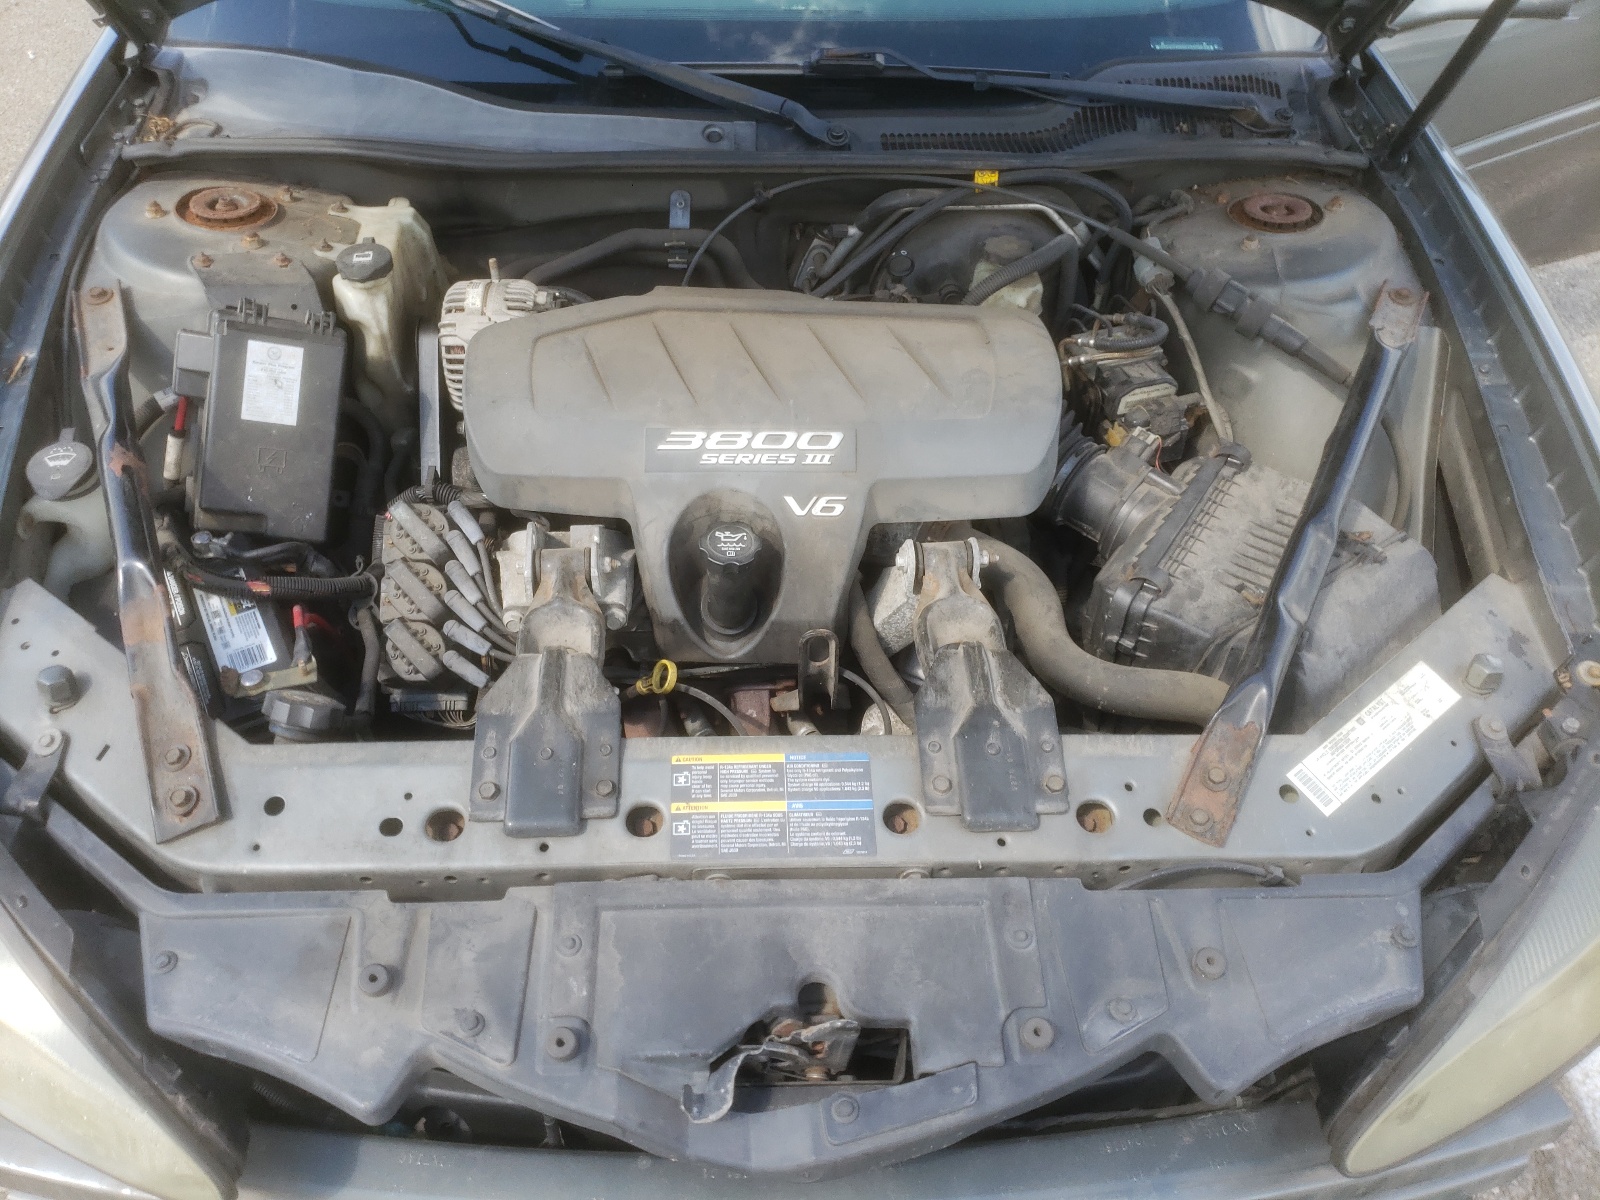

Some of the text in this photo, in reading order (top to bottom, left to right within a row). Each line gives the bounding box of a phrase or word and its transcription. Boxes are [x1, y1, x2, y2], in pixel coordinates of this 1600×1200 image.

[657, 432, 844, 449] 3800
[700, 454, 834, 464] SERIES III
[784, 496, 847, 516] V6
